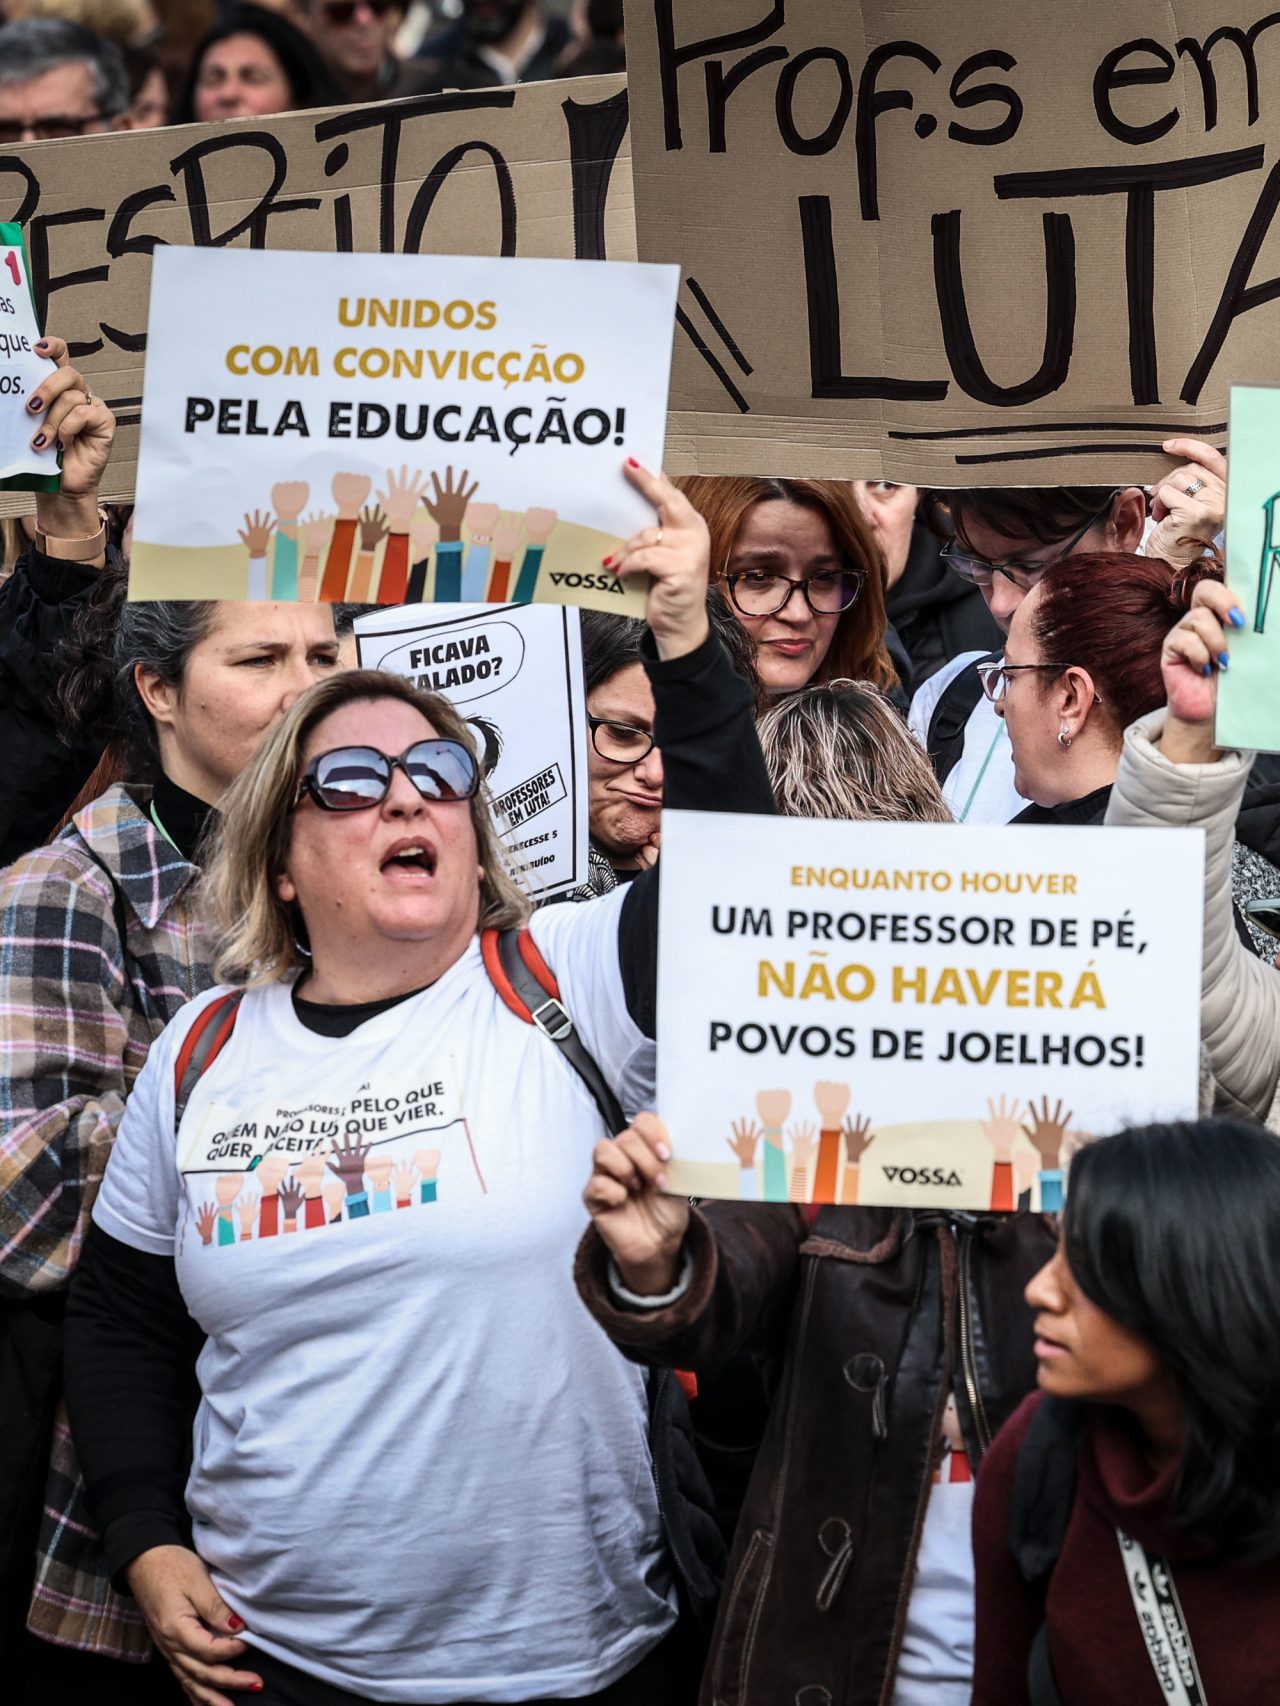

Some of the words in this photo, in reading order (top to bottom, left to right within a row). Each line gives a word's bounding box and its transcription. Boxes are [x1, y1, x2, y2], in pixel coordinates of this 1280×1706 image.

[655, 0, 1022, 221] Prof.s
[338, 298, 497, 330] UNIDOS
[226, 344, 319, 377] COM
[332, 344, 585, 390] CONVICÇÃO
[184, 397, 310, 437] PELA
[328, 397, 626, 456] EDUCAÇÃO!
[549, 572, 625, 595] VOSSA
[410, 635, 490, 669] FICAVA
[508, 807, 524, 826] EM
[526, 790, 551, 817] LUTA!
[790, 866, 952, 892] ENQUANTO
[960, 872, 1078, 895] HOUVER
[711, 905, 773, 936] UM
[787, 911, 1014, 947] PROFESSOR
[1030, 919, 1079, 947] DE
[1092, 911, 1147, 954] PÉ,
[758, 952, 875, 1002] NÃO
[892, 960, 1106, 1009] HAVERÁ
[709, 1022, 856, 1057] POVOS
[872, 1029, 924, 1060] DE
[939, 1032, 1144, 1067] JOELHOS!
[352, 1098, 400, 1113] PELO
[405, 1081, 444, 1104] QUE
[345, 1118, 387, 1134] QUE
[394, 1102, 444, 1124] VIER.
[882, 1166, 962, 1187] VOSSA
